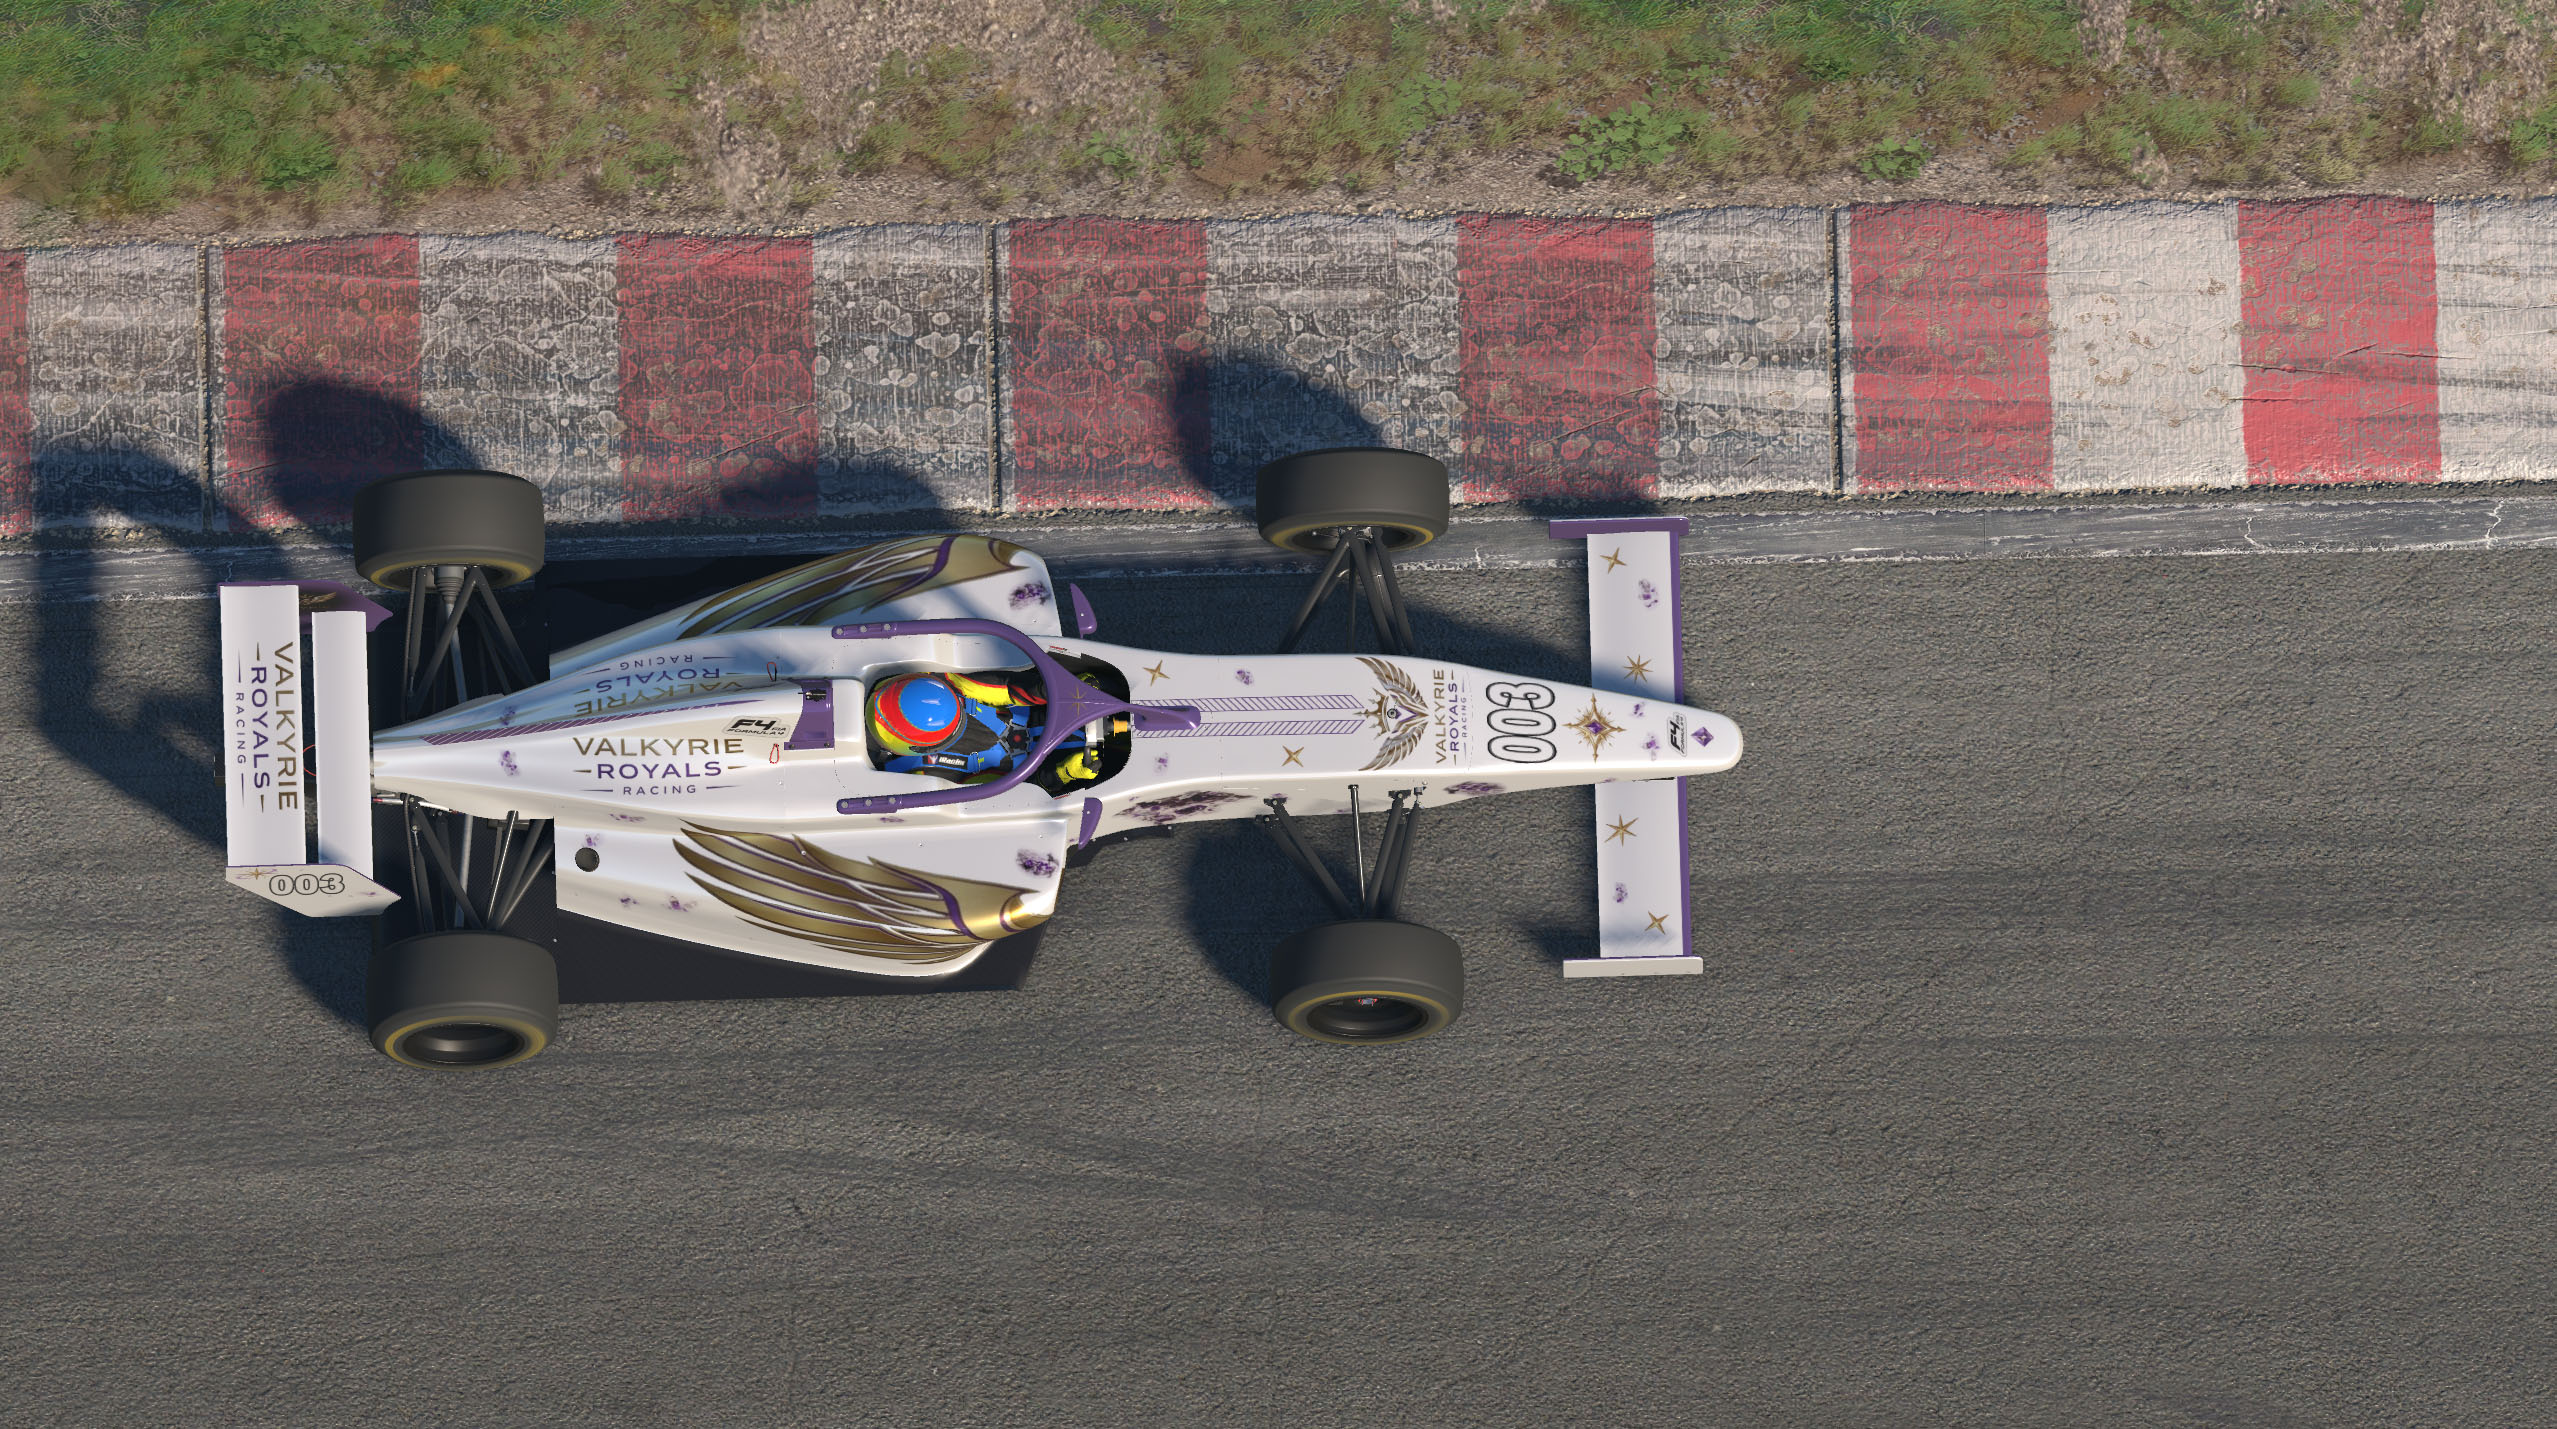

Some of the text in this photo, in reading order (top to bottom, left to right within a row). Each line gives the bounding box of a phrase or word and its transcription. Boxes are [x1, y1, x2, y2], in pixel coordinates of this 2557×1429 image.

[619, 654, 693, 671] RACING
[595, 667, 720, 693] ROYALS
[574, 681, 743, 717] VALKYRIE
[235, 692, 247, 764] RACING
[251, 667, 270, 788] ROYALS
[274, 641, 299, 810] VALKYRIE
[730, 718, 777, 731] F4
[1433, 669, 1447, 764] VALKYRIE
[1448, 682, 1460, 752] ROYALS
[1485, 681, 1558, 764] 003
[572, 737, 744, 757] VALKYRIE
[1669, 719, 1681, 751] F4
[597, 761, 722, 780] ROYALS
[623, 784, 697, 796] RACING
[269, 872, 346, 897] 003
